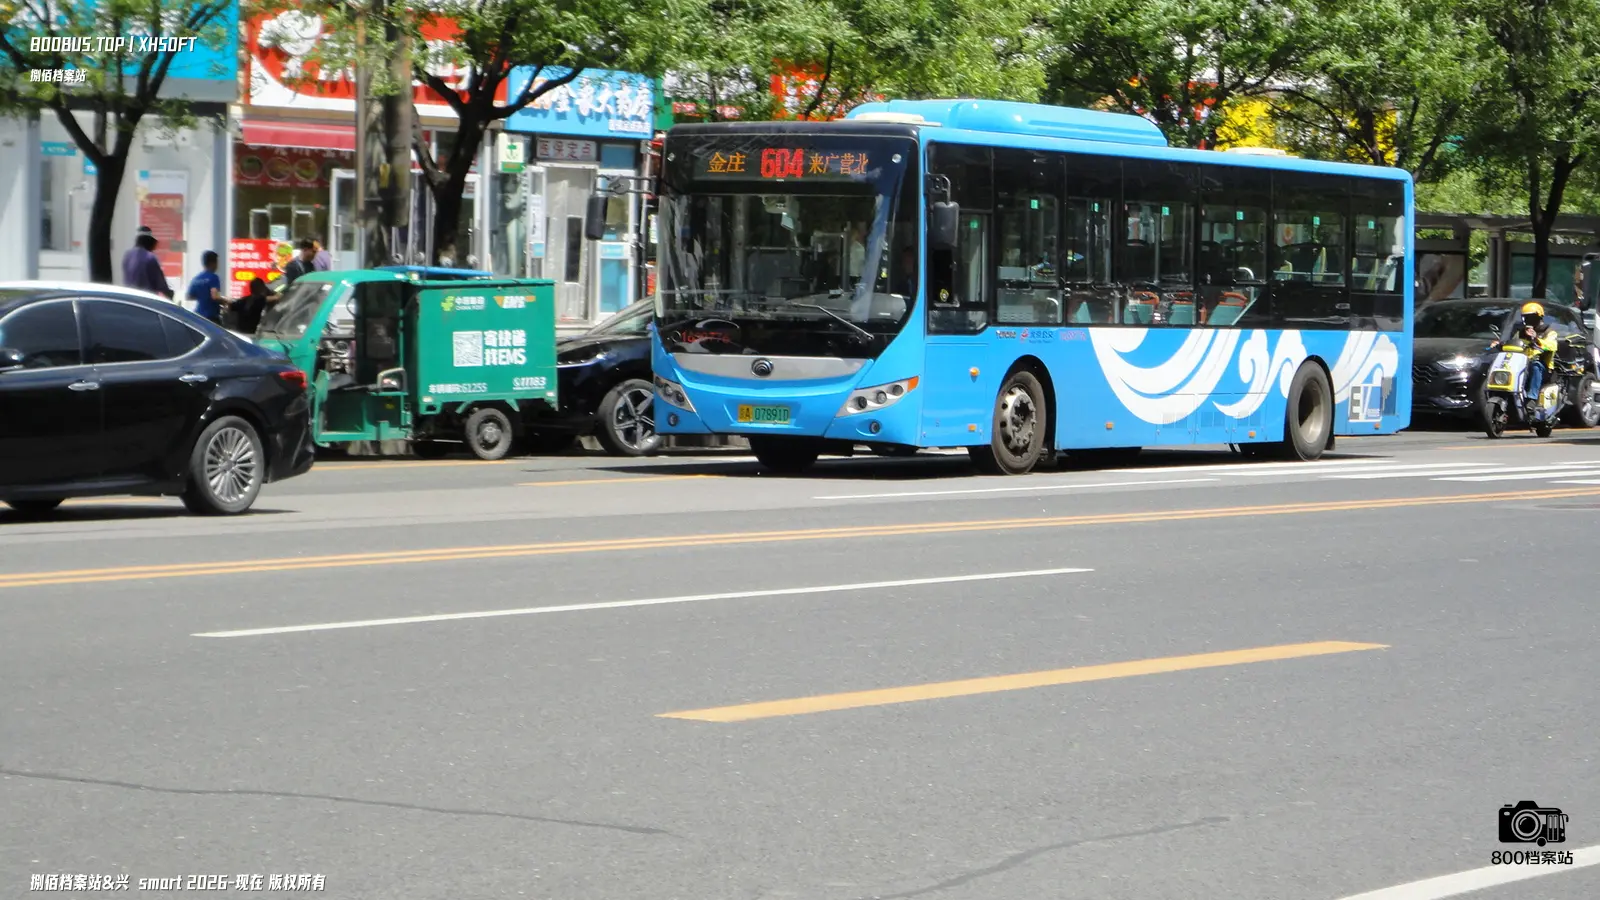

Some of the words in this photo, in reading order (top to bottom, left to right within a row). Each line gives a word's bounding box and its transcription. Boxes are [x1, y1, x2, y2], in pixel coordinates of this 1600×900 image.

[539, 140, 592, 159] 医保定点
[707, 152, 746, 173] 金庄
[761, 148, 804, 178] 604
[809, 152, 869, 175] 来广营北
[483, 329, 527, 347] 寄快递
[484, 348, 527, 366] 找EMS
